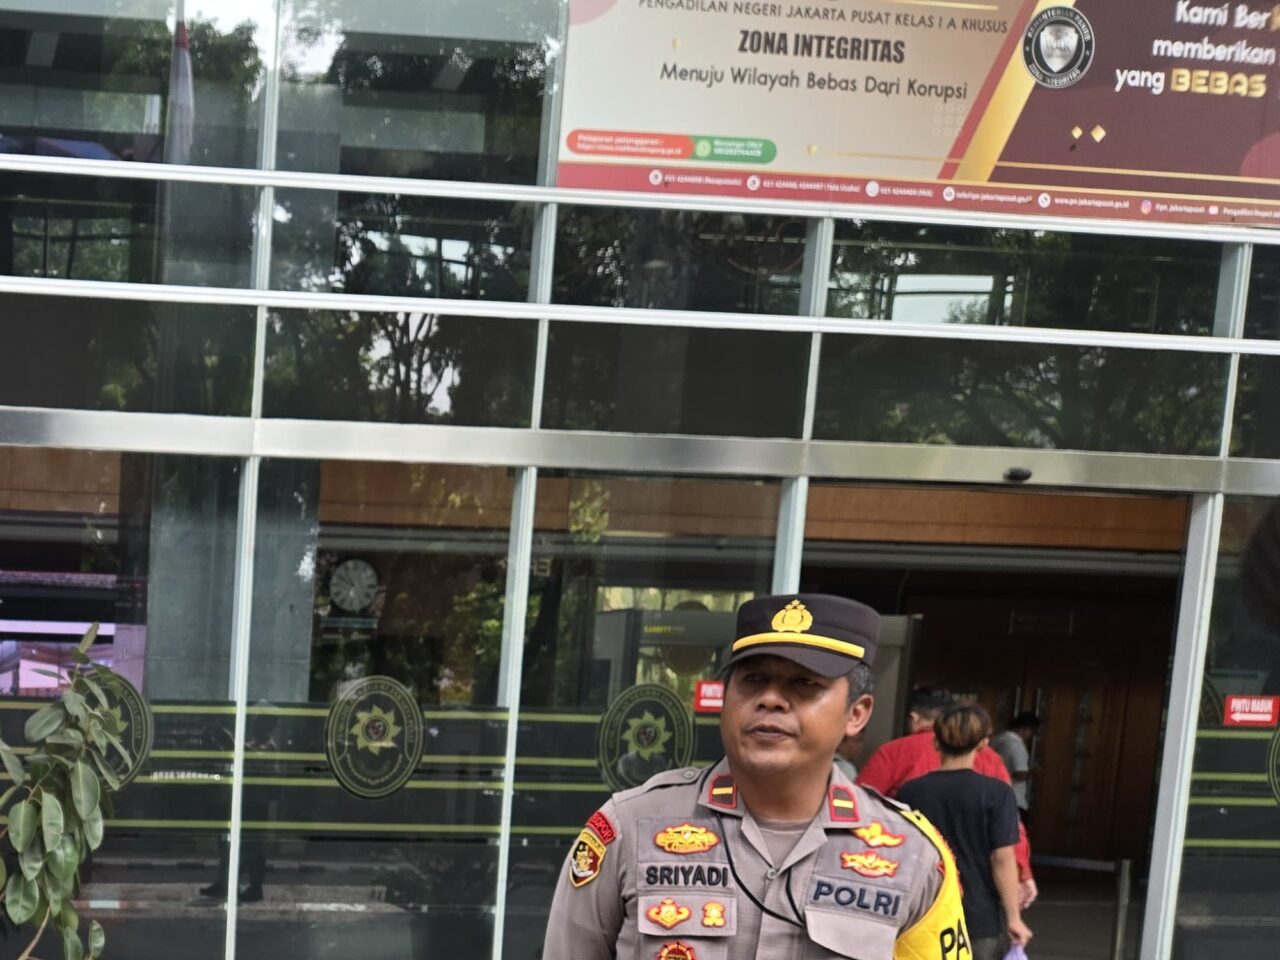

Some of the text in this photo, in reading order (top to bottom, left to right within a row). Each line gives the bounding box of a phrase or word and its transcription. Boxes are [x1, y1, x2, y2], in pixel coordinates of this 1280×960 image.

[639, 0, 728, 13] PENGADILAN
[733, 0, 781, 17] NEGERI
[786, 5, 846, 21] JAKARTA
[851, 10, 890, 25] PUSAT
[895, 13, 934, 28] KELAS
[947, 18, 957, 30] A
[961, 18, 1008, 34] KHUSUS
[1176, 0, 1229, 25] Kami
[738, 29, 905, 63] ZONA INTEGRITAS
[1152, 36, 1277, 65] memberikan
[660, 62, 967, 102] Menuju Wilayah Bebas Dari Korupsi
[1114, 67, 1268, 98] yang BEBAS
[646, 865, 728, 888] SRIYADI
[812, 880, 901, 917] POLRI
